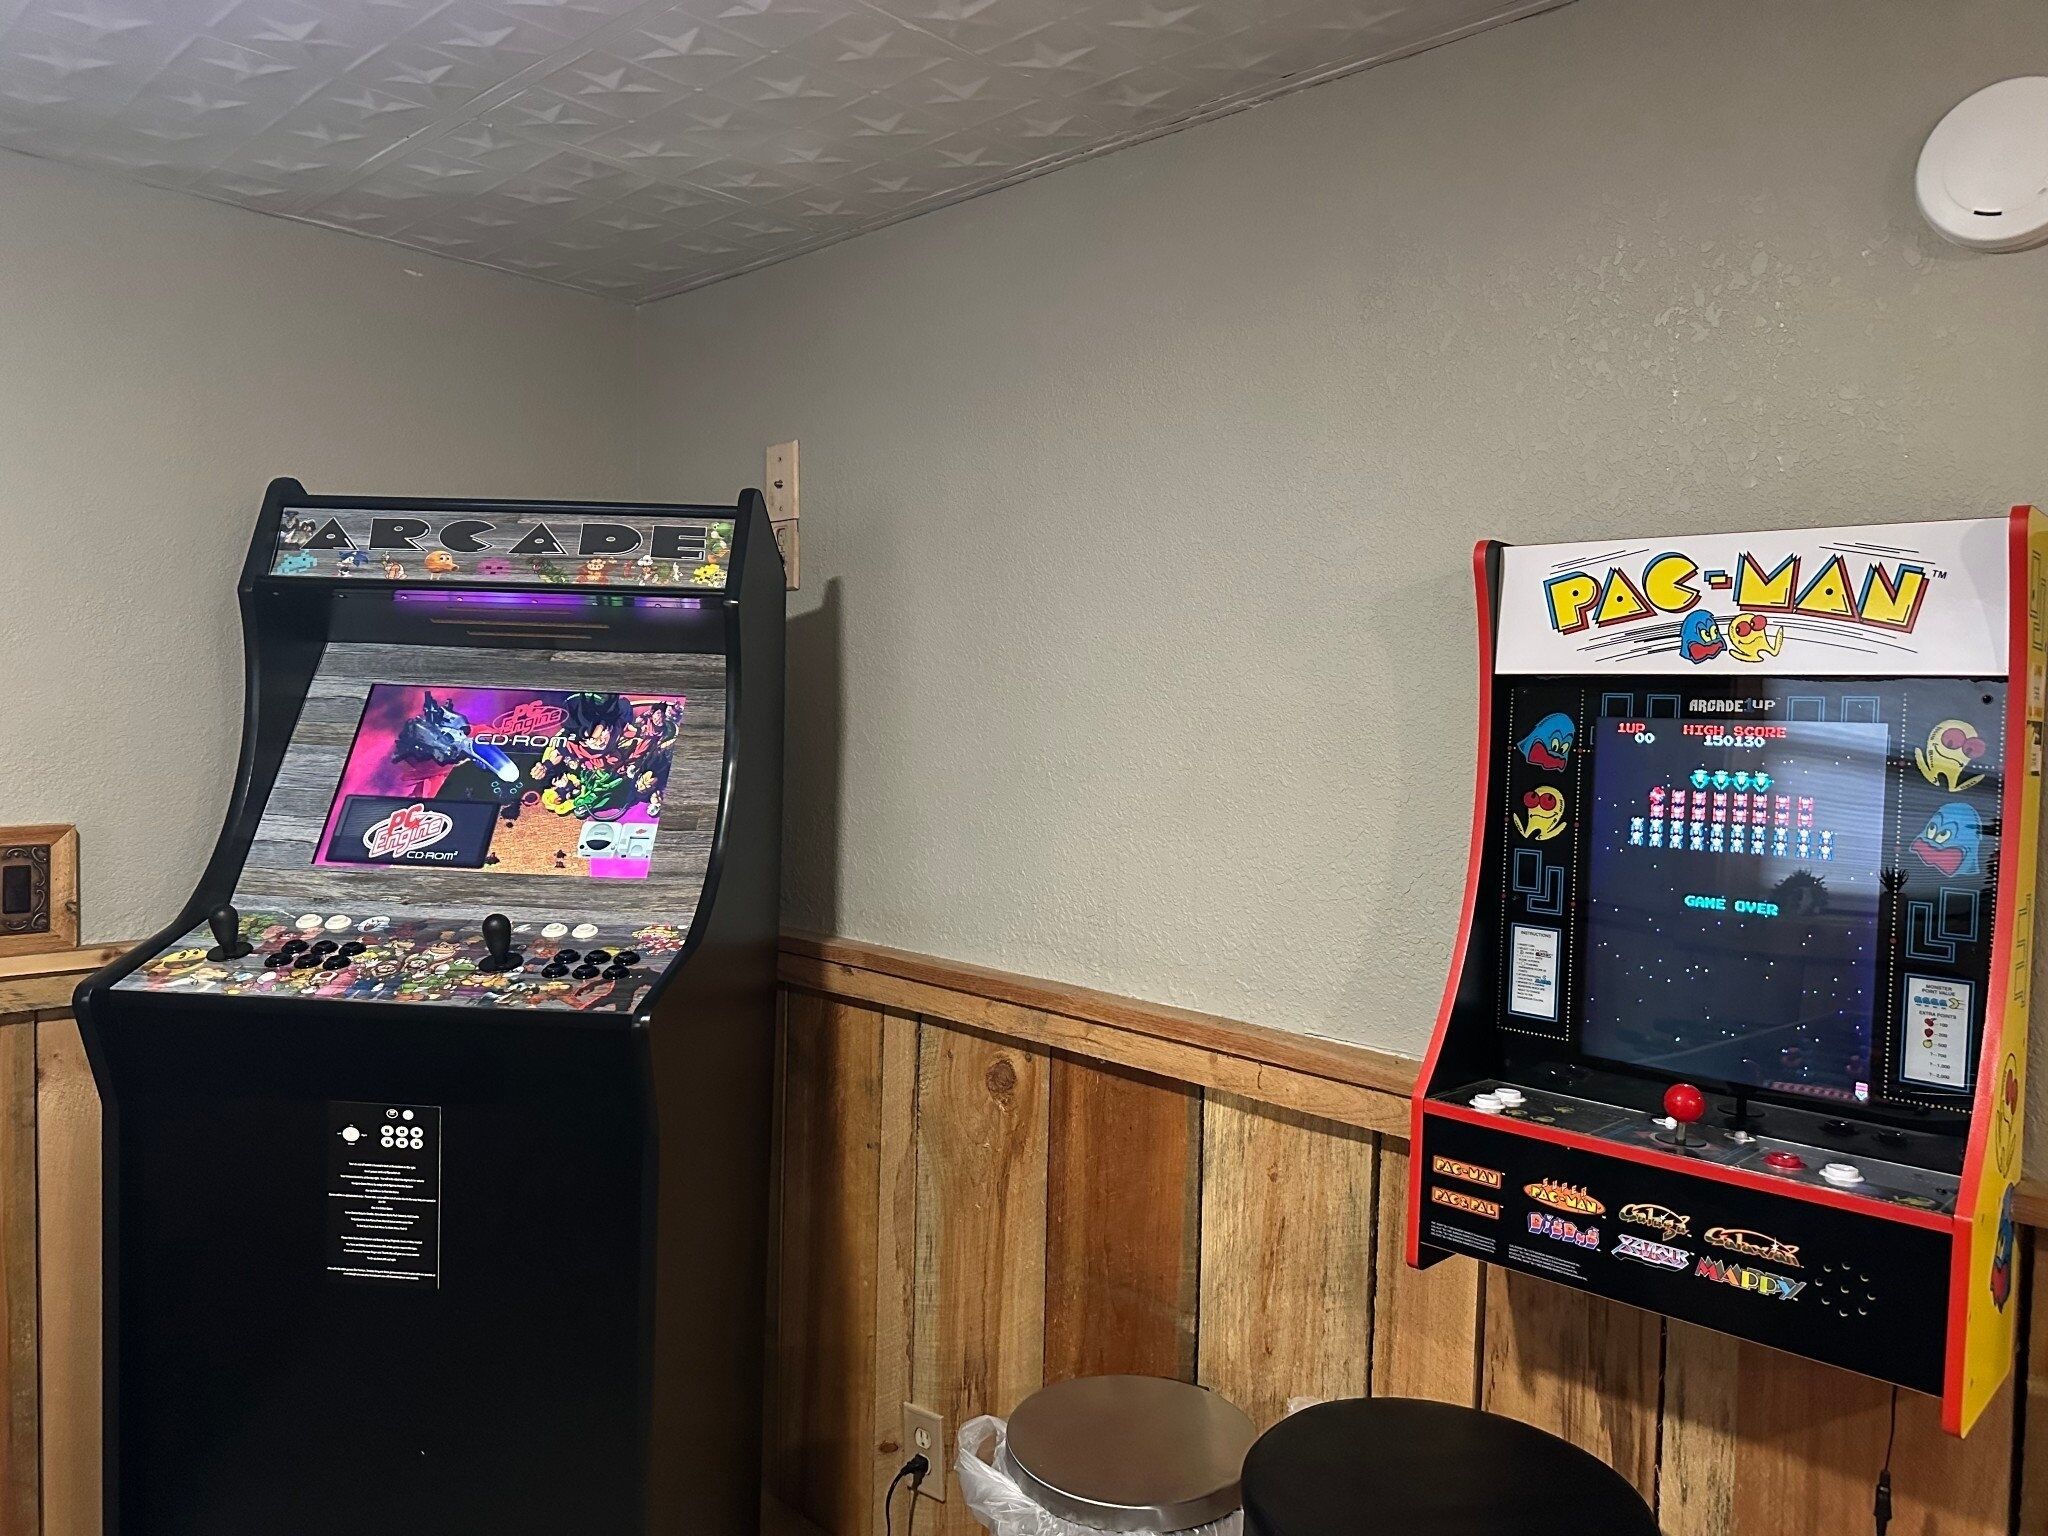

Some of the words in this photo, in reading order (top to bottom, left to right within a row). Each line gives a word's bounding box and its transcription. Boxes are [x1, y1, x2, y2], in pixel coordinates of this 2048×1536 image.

[300, 516, 707, 561] ARCADE
[1543, 551, 1930, 635] PAC-MAN
[502, 709, 562, 735] Engine
[513, 701, 546, 720] PC
[1617, 722, 1646, 733] 1UP
[1683, 724, 1725, 736] HIGH
[1733, 726, 1787, 738] SCORE
[1634, 732, 1656, 744] 00
[1703, 735, 1766, 748] 150130
[388, 803, 425, 833] PC
[369, 817, 444, 858] Engine
[1684, 895, 1726, 910] GAME
[1734, 900, 1779, 916] OVER
[1435, 1157, 1499, 1186] PAC-MAN
[1530, 1185, 1598, 1214] PAC-MAN
[1542, 1177, 1588, 1197] SUPER
[1694, 1255, 1807, 1300] MAPPY
